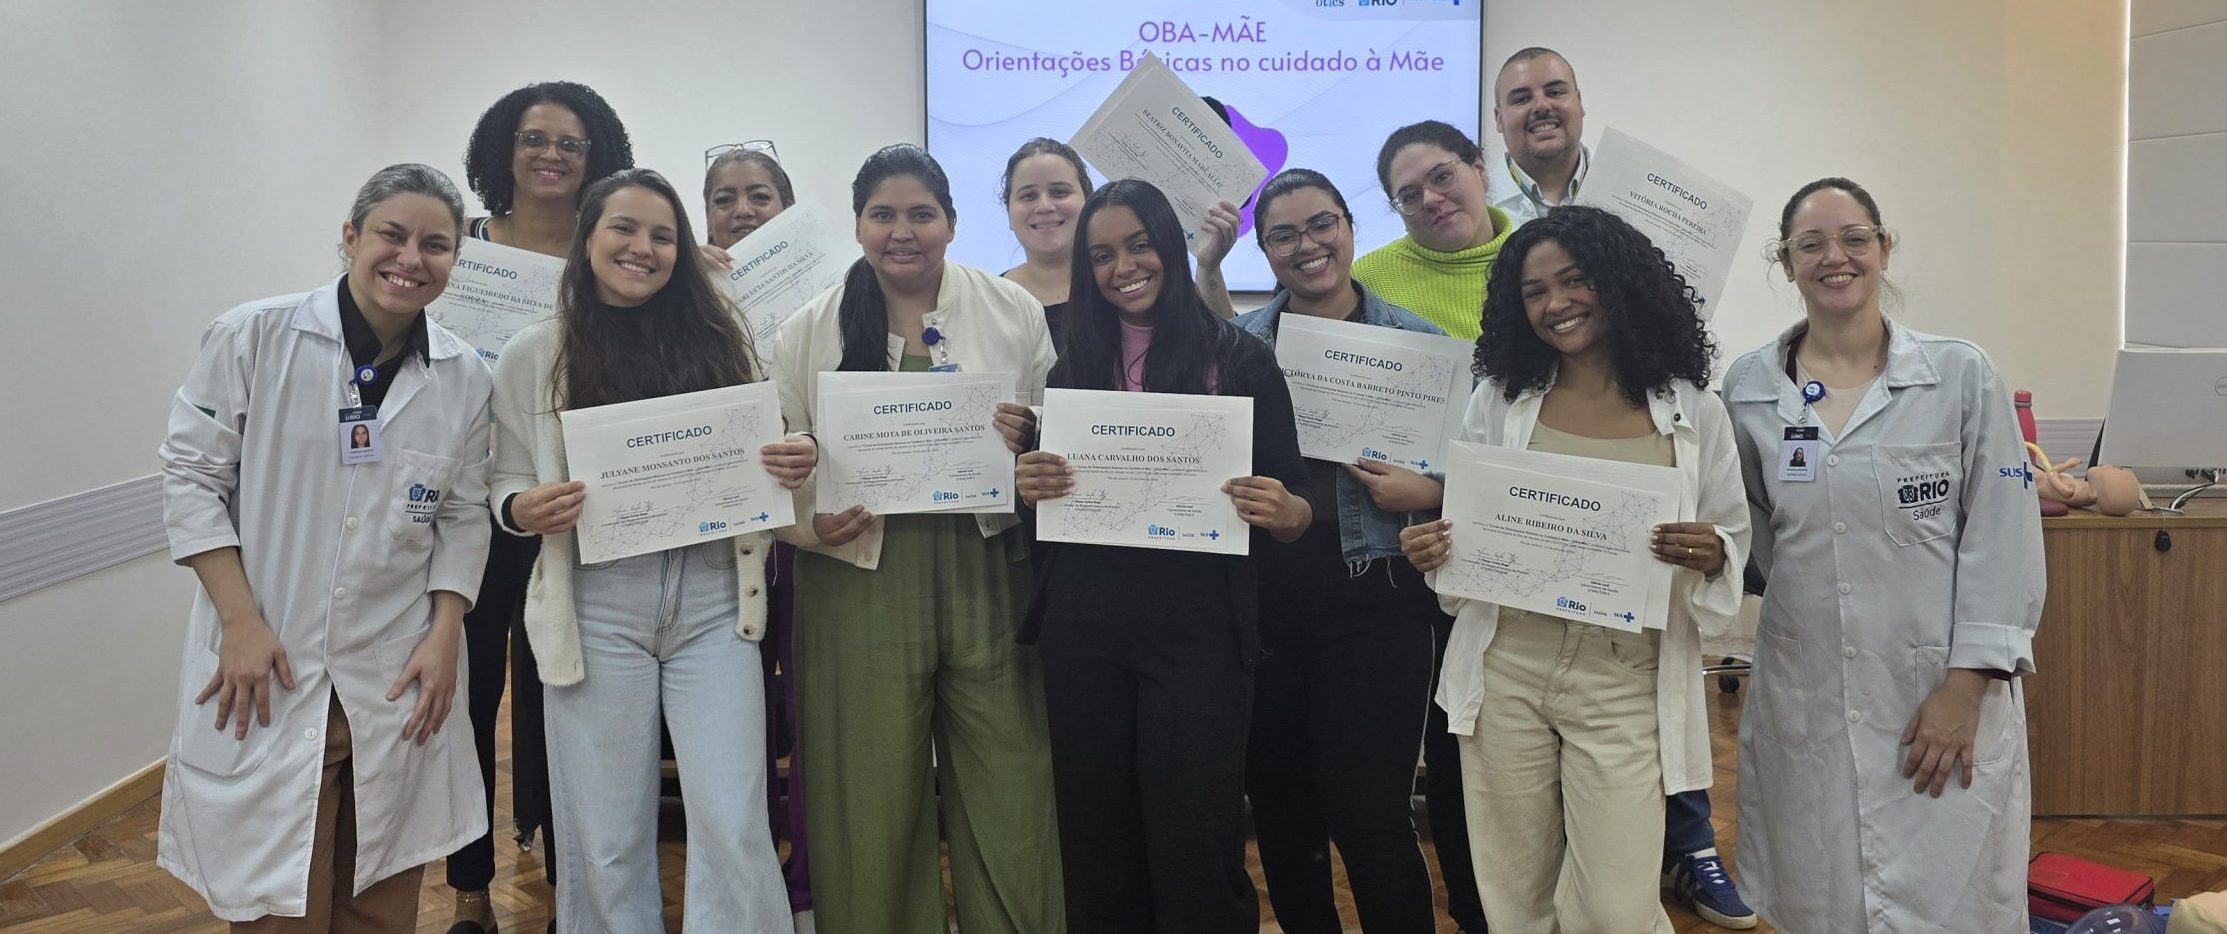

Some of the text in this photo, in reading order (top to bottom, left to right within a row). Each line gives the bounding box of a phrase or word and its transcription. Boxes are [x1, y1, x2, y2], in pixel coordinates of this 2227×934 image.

[1138, 15, 1267, 43] OBA-MÃE
[962, 48, 1445, 78] Orientações Bicas no cuidado à Mãe
[1171, 106, 1223, 159] CERTIFICADO
[1646, 172, 1708, 210] CERTIFICADO
[453, 257, 518, 280] RTIFICADO
[730, 240, 789, 282] CERTIFICADO
[1324, 349, 1403, 372] CERTIFICADO
[1316, 374, 1328, 383] DA
[1329, 376, 1355, 388] COSTA
[1356, 382, 1395, 395] BARRETO
[1396, 389, 1422, 400] PINTO
[1422, 394, 1446, 404] PIRES
[873, 400, 953, 415] CERTIFICADO
[627, 425, 713, 449] CERTIFICADO
[843, 424, 985, 442] CARINE MOTA DE OLIVEIRA SANTOS
[1091, 424, 1176, 438] CERTIFICADO
[600, 466, 641, 480] JULYANE
[641, 456, 692, 473] MONSANTO
[693, 453, 711, 464] DOS
[711, 447, 745, 460] SANTOS
[1067, 452, 1200, 464] LUANA CARVALHO DOS SANTOS
[1371, 450, 1387, 461] Rio
[1896, 471, 1950, 484] PREFEITURA
[1999, 467, 2024, 478] SUS
[423, 489, 440, 503] Ri
[943, 491, 959, 501] Rio
[1508, 485, 1602, 513] CERTIFICADO
[1919, 478, 1950, 502] RIO
[412, 513, 431, 524] SAÚD
[1912, 506, 1942, 521] Saúde
[709, 521, 727, 531] Rio
[1158, 526, 1176, 536] Rio
[1494, 513, 1608, 541] ALINE RIBEIRO DA SILVA
[1568, 600, 1587, 612] Rio
